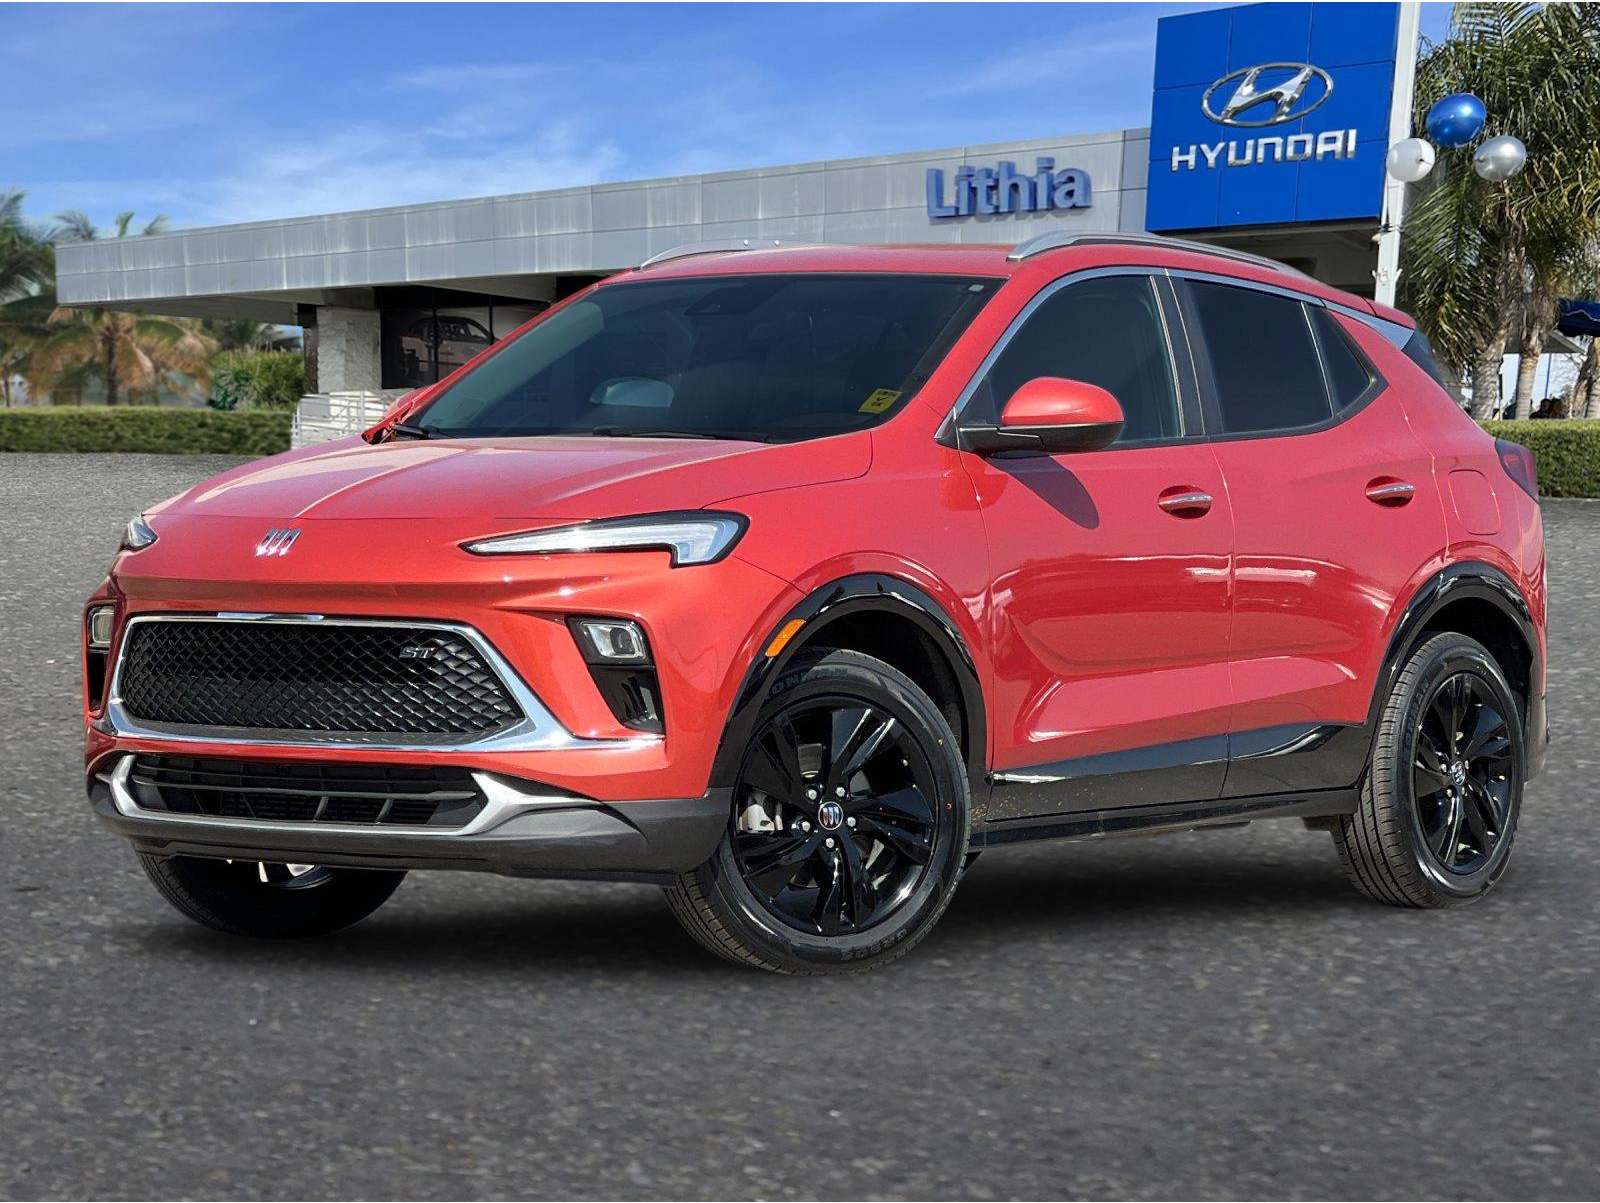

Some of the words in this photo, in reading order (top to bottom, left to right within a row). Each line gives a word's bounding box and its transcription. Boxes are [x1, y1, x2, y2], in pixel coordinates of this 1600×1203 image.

[1171, 128, 1358, 172] HYUNDAI
[926, 156, 1093, 218] Lithia
[399, 646, 436, 659] ST
